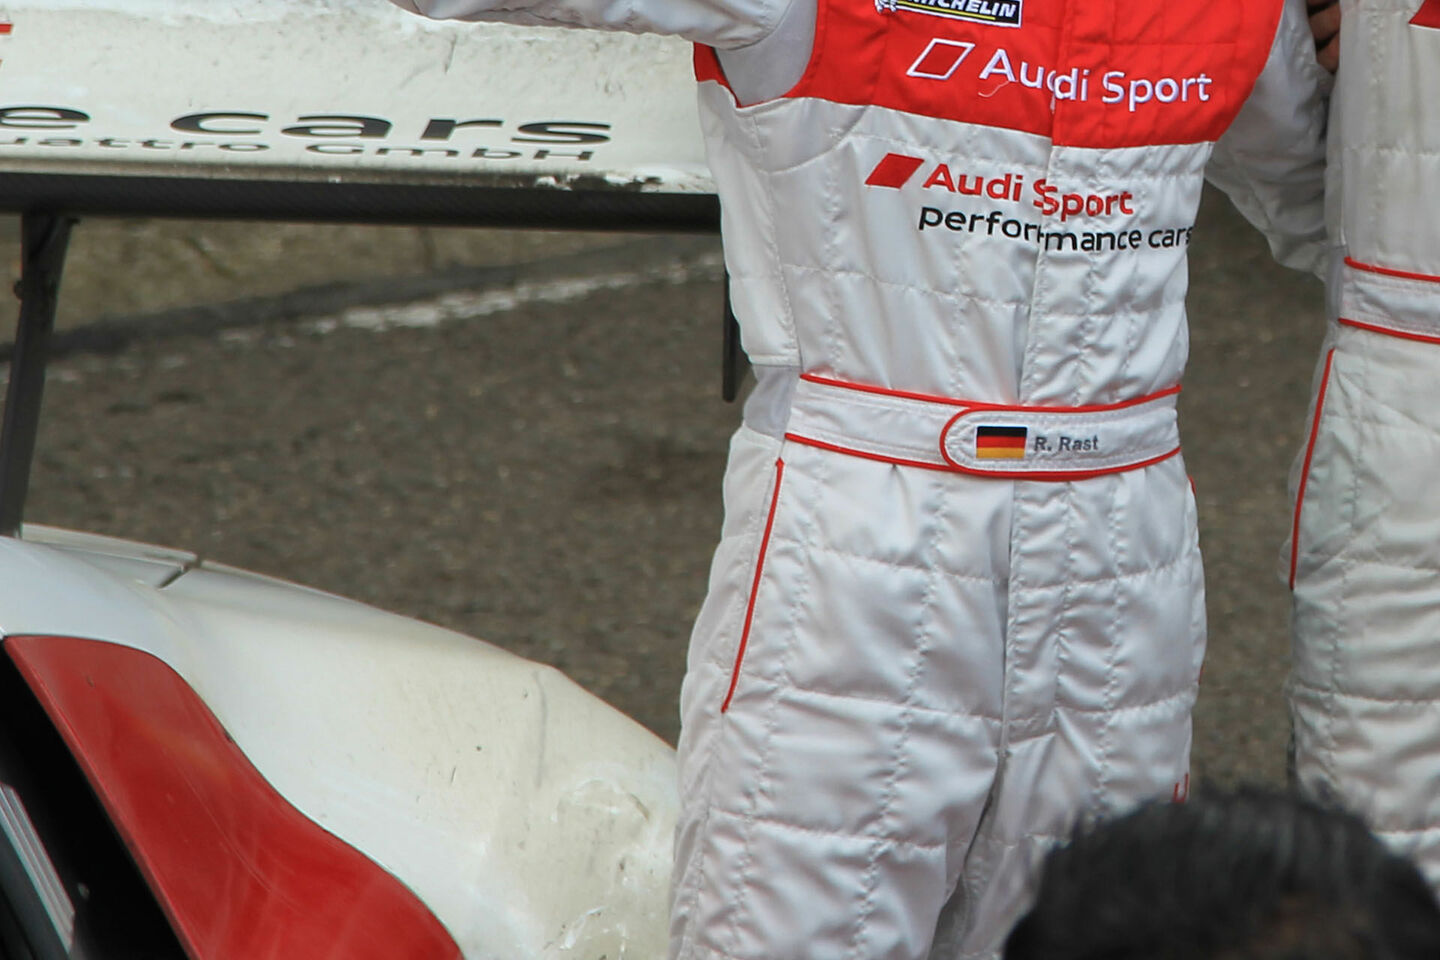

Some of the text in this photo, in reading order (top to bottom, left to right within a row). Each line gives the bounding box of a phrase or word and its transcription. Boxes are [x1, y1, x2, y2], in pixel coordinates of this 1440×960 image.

[979, 48, 1212, 112] Audi Sport
[170, 111, 611, 144] cars
[0, 136, 595, 162] uattro GmbH
[923, 163, 1136, 222] Audi Sport
[918, 206, 1193, 252] performance cars
[1034, 435, 1098, 452] R. Rast
